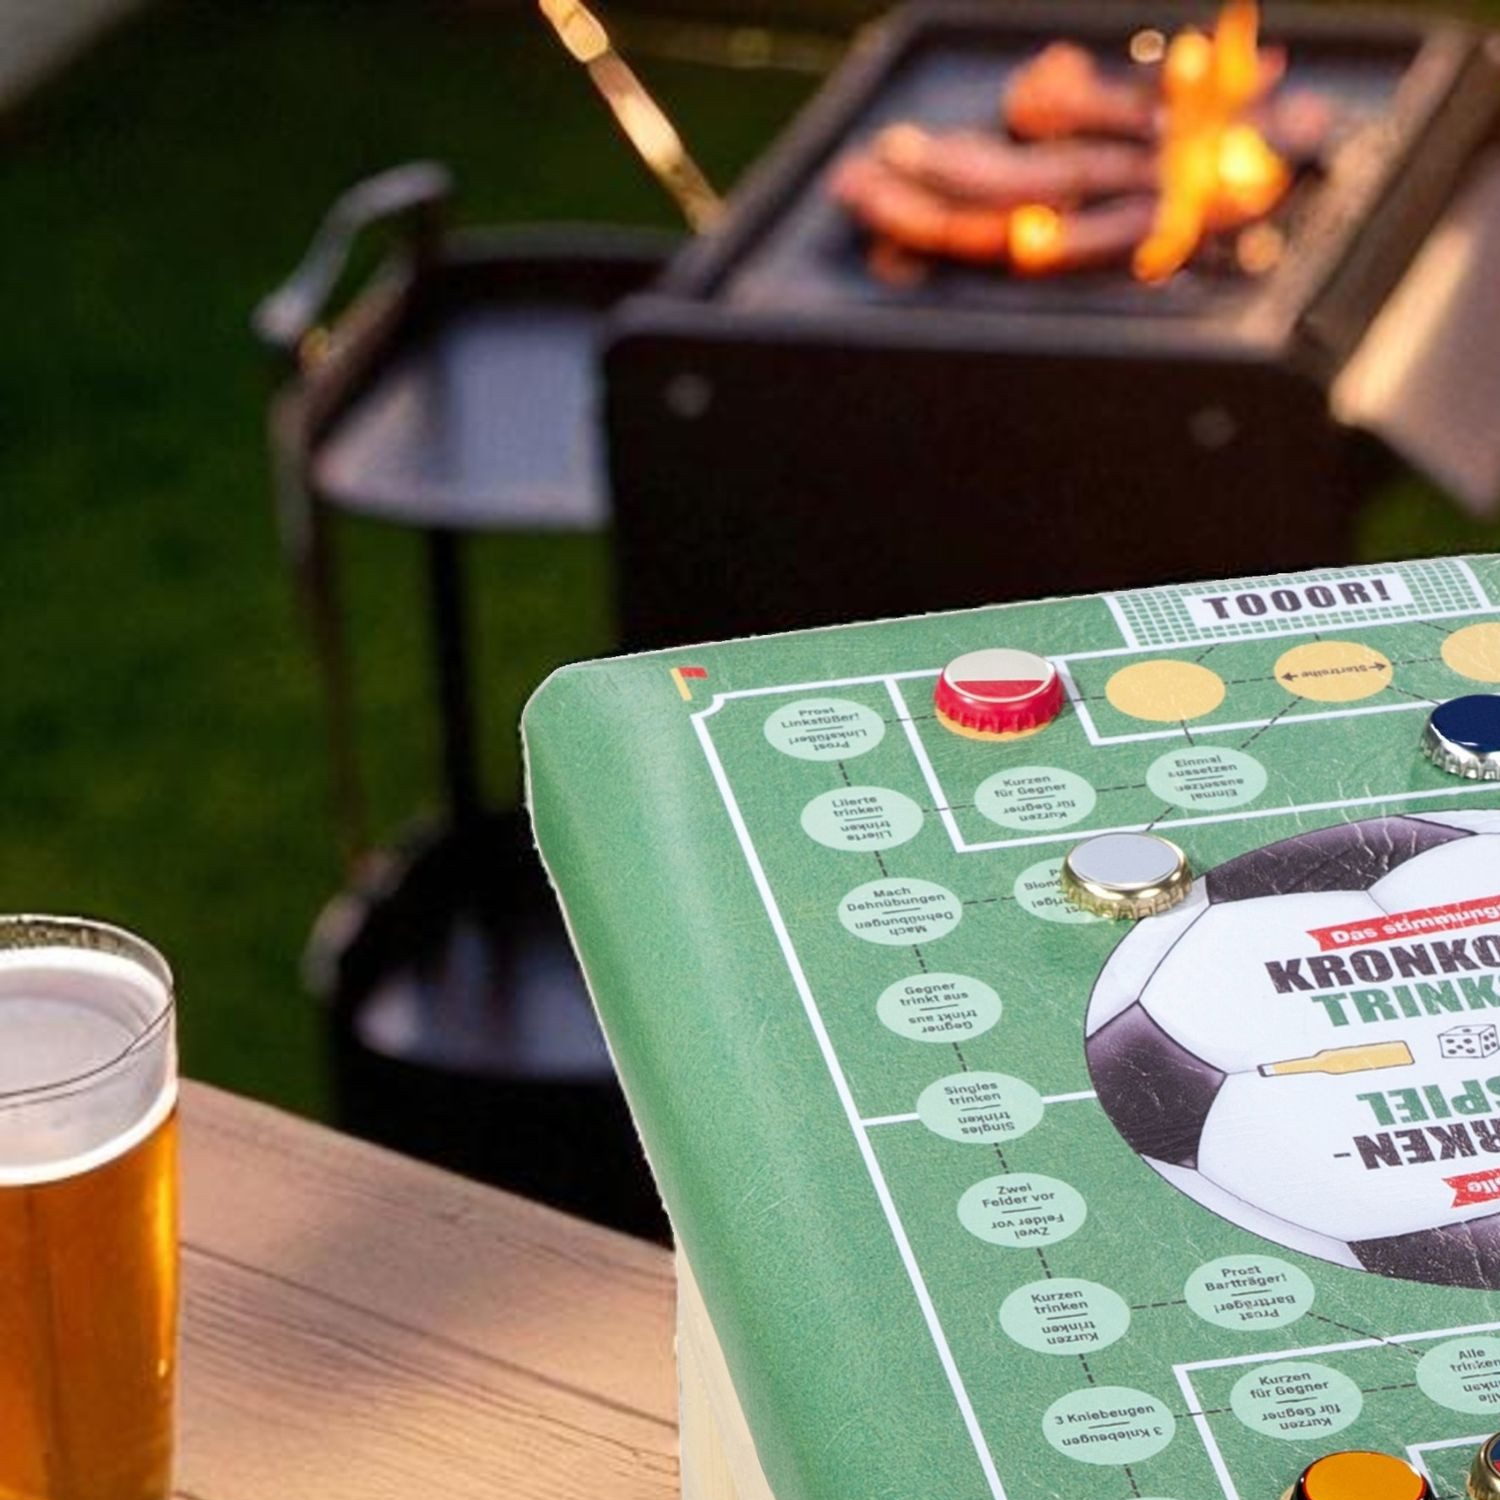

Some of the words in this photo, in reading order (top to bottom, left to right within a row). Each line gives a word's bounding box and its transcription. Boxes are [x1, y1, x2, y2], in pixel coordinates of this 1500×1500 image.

[1202, 579, 1392, 620] TOOOR!
[1300, 664, 1368, 678] Startreihe
[798, 707, 835, 716] Prost
[1002, 776, 1052, 787] Kurzen
[993, 789, 1014, 798] für
[1017, 783, 1066, 795] Gegner
[833, 805, 884, 818] trinken
[840, 820, 892, 833] trinken
[873, 887, 912, 899] Mach
[846, 893, 946, 912] Dehnübungen
[855, 911, 955, 930] Dehnübungen
[889, 924, 928, 937] Mach
[1329, 924, 1377, 945] Das
[903, 982, 957, 996] Gegner
[899, 994, 940, 1007] trinkt
[943, 992, 969, 1003] aus
[907, 1014, 935, 1025] aus
[937, 1009, 978, 1022] trinkt
[921, 1020, 973, 1034] Gegner
[943, 1082, 999, 1096] Singles
[949, 1092, 1002, 1106] trinken
[957, 1111, 1011, 1125] trinken
[961, 1121, 1016, 1135] Singles
[996, 1183, 1032, 1195] Zwei
[981, 1195, 1028, 1209] Felder
[1031, 1191, 1056, 1202] vor
[991, 1219, 1015, 1230] vor
[1017, 1214, 1065, 1227] Felder
[1014, 1227, 1051, 1240] Zwei
[1220, 1265, 1262, 1277] Prost
[1204, 1273, 1288, 1292] Bartträger!
[1030, 1289, 1084, 1304] Kurzen
[1034, 1301, 1089, 1316] trinken
[1239, 1309, 1280, 1321] Prost
[1041, 1320, 1096, 1334] trinken
[1046, 1331, 1100, 1346] Kurzen
[1458, 1348, 1486, 1360] Alle
[1258, 1372, 1312, 1386] Kurzen
[1250, 1387, 1273, 1400] für
[1275, 1380, 1330, 1396] Gegner
[1054, 1415, 1065, 1425] 3
[1066, 1404, 1156, 1423] Kniebeugen
[1261, 1407, 1316, 1422] Gegner
[1320, 1403, 1342, 1415] für
[1153, 1426, 1164, 1436] 3
[1279, 1417, 1332, 1431] Kurzen
[1062, 1427, 1151, 1446] Kniebeugen
